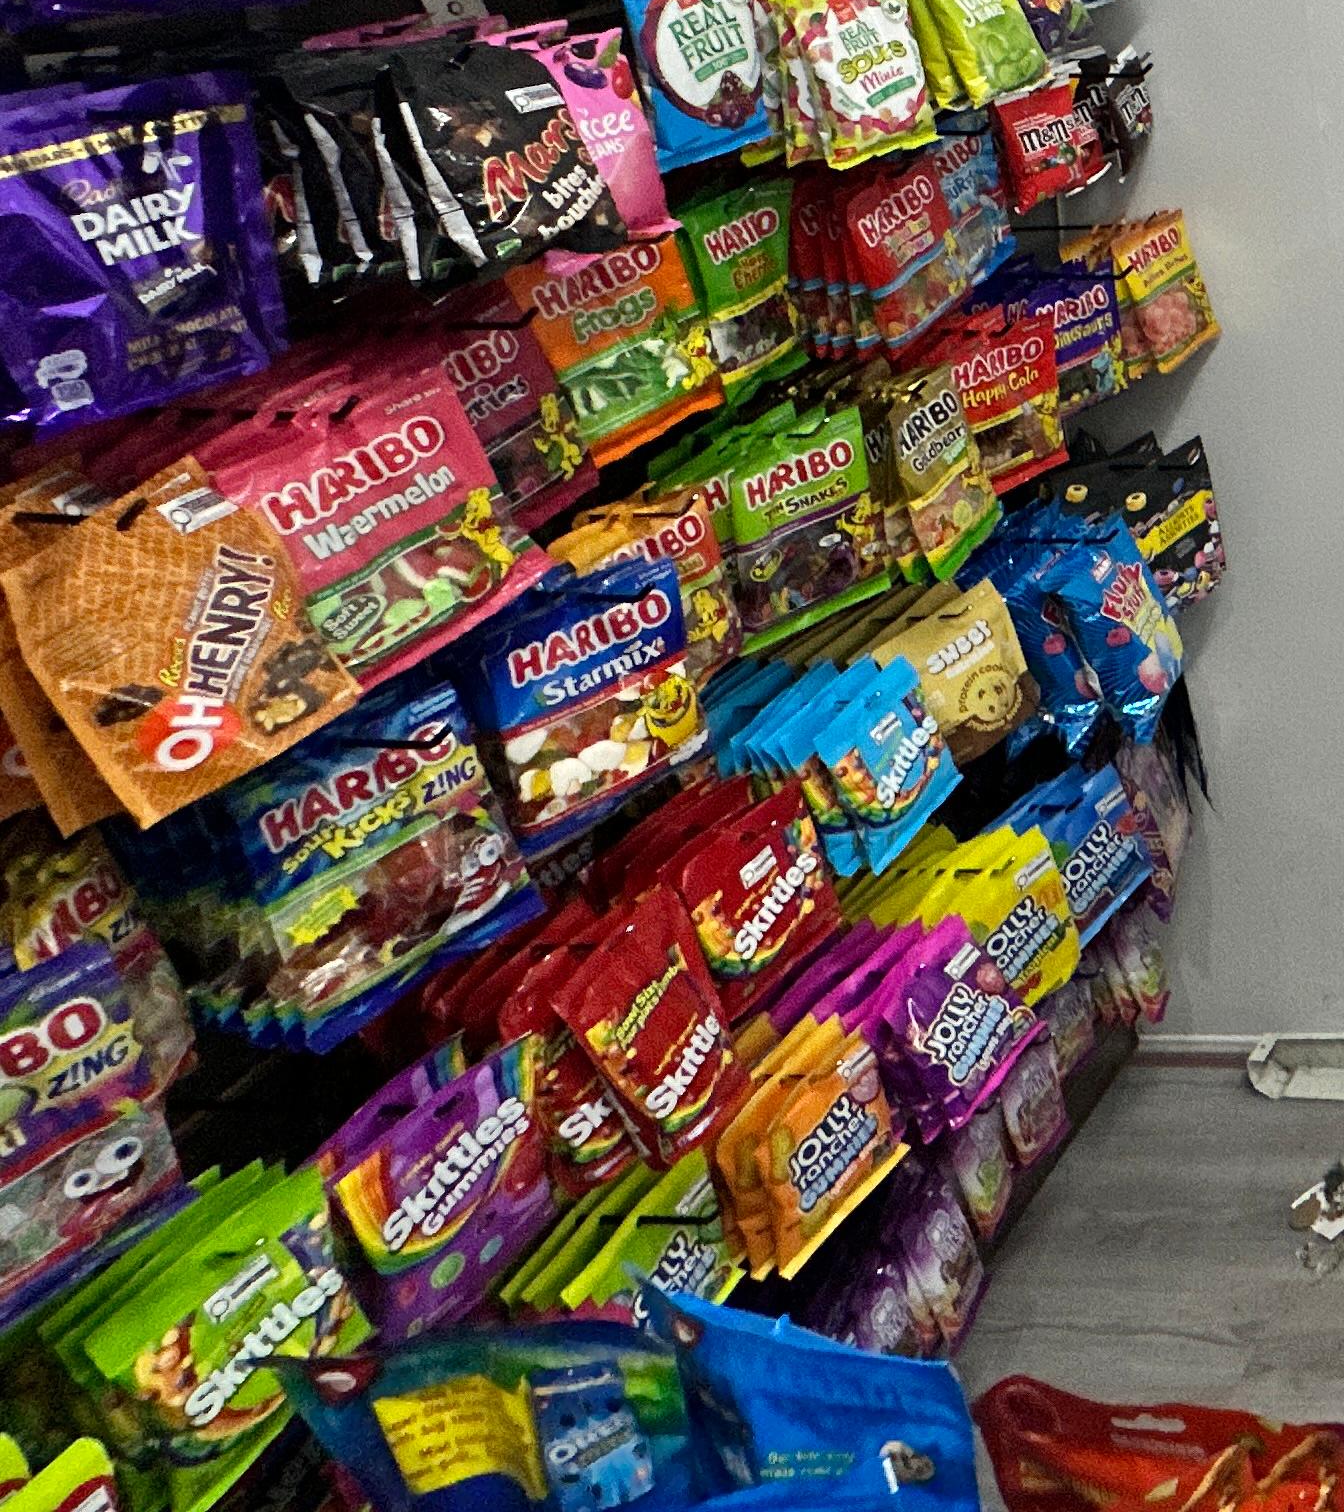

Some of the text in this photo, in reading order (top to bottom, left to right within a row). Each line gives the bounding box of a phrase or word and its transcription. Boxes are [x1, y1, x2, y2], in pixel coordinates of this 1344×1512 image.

[668, 0, 738, 49] REAL
[680, 23, 746, 71] FRUIT
[837, 20, 877, 44] REAL
[843, 31, 880, 57] FRUIT
[71, 182, 195, 242] DAIRY
[96, 215, 202, 267] MILK
[531, 243, 661, 321] HARIBO
[572, 287, 658, 345] frogs
[951, 337, 1044, 390] HARIBO
[260, 414, 447, 536] HARIBO
[744, 439, 856, 513] HARIBO
[784, 477, 848, 515] SNAKES
[153, 542, 279, 773] OH HENRY!
[506, 589, 672, 689] HARIBO
[541, 637, 666, 707] Starmix
[876, 715, 939, 809] Skittles
[733, 852, 818, 960] Skittles
[928, 985, 975, 1059] JOLLY
[947, 996, 990, 1064] rancher
[645, 1012, 722, 1120] Skittle
[381, 1096, 526, 1252] Skittles
[421, 1111, 531, 1237] Gummies
[792, 1095, 854, 1180] JOLLY
[798, 1108, 868, 1190] rancher
[183, 1268, 344, 1428] Skittles
